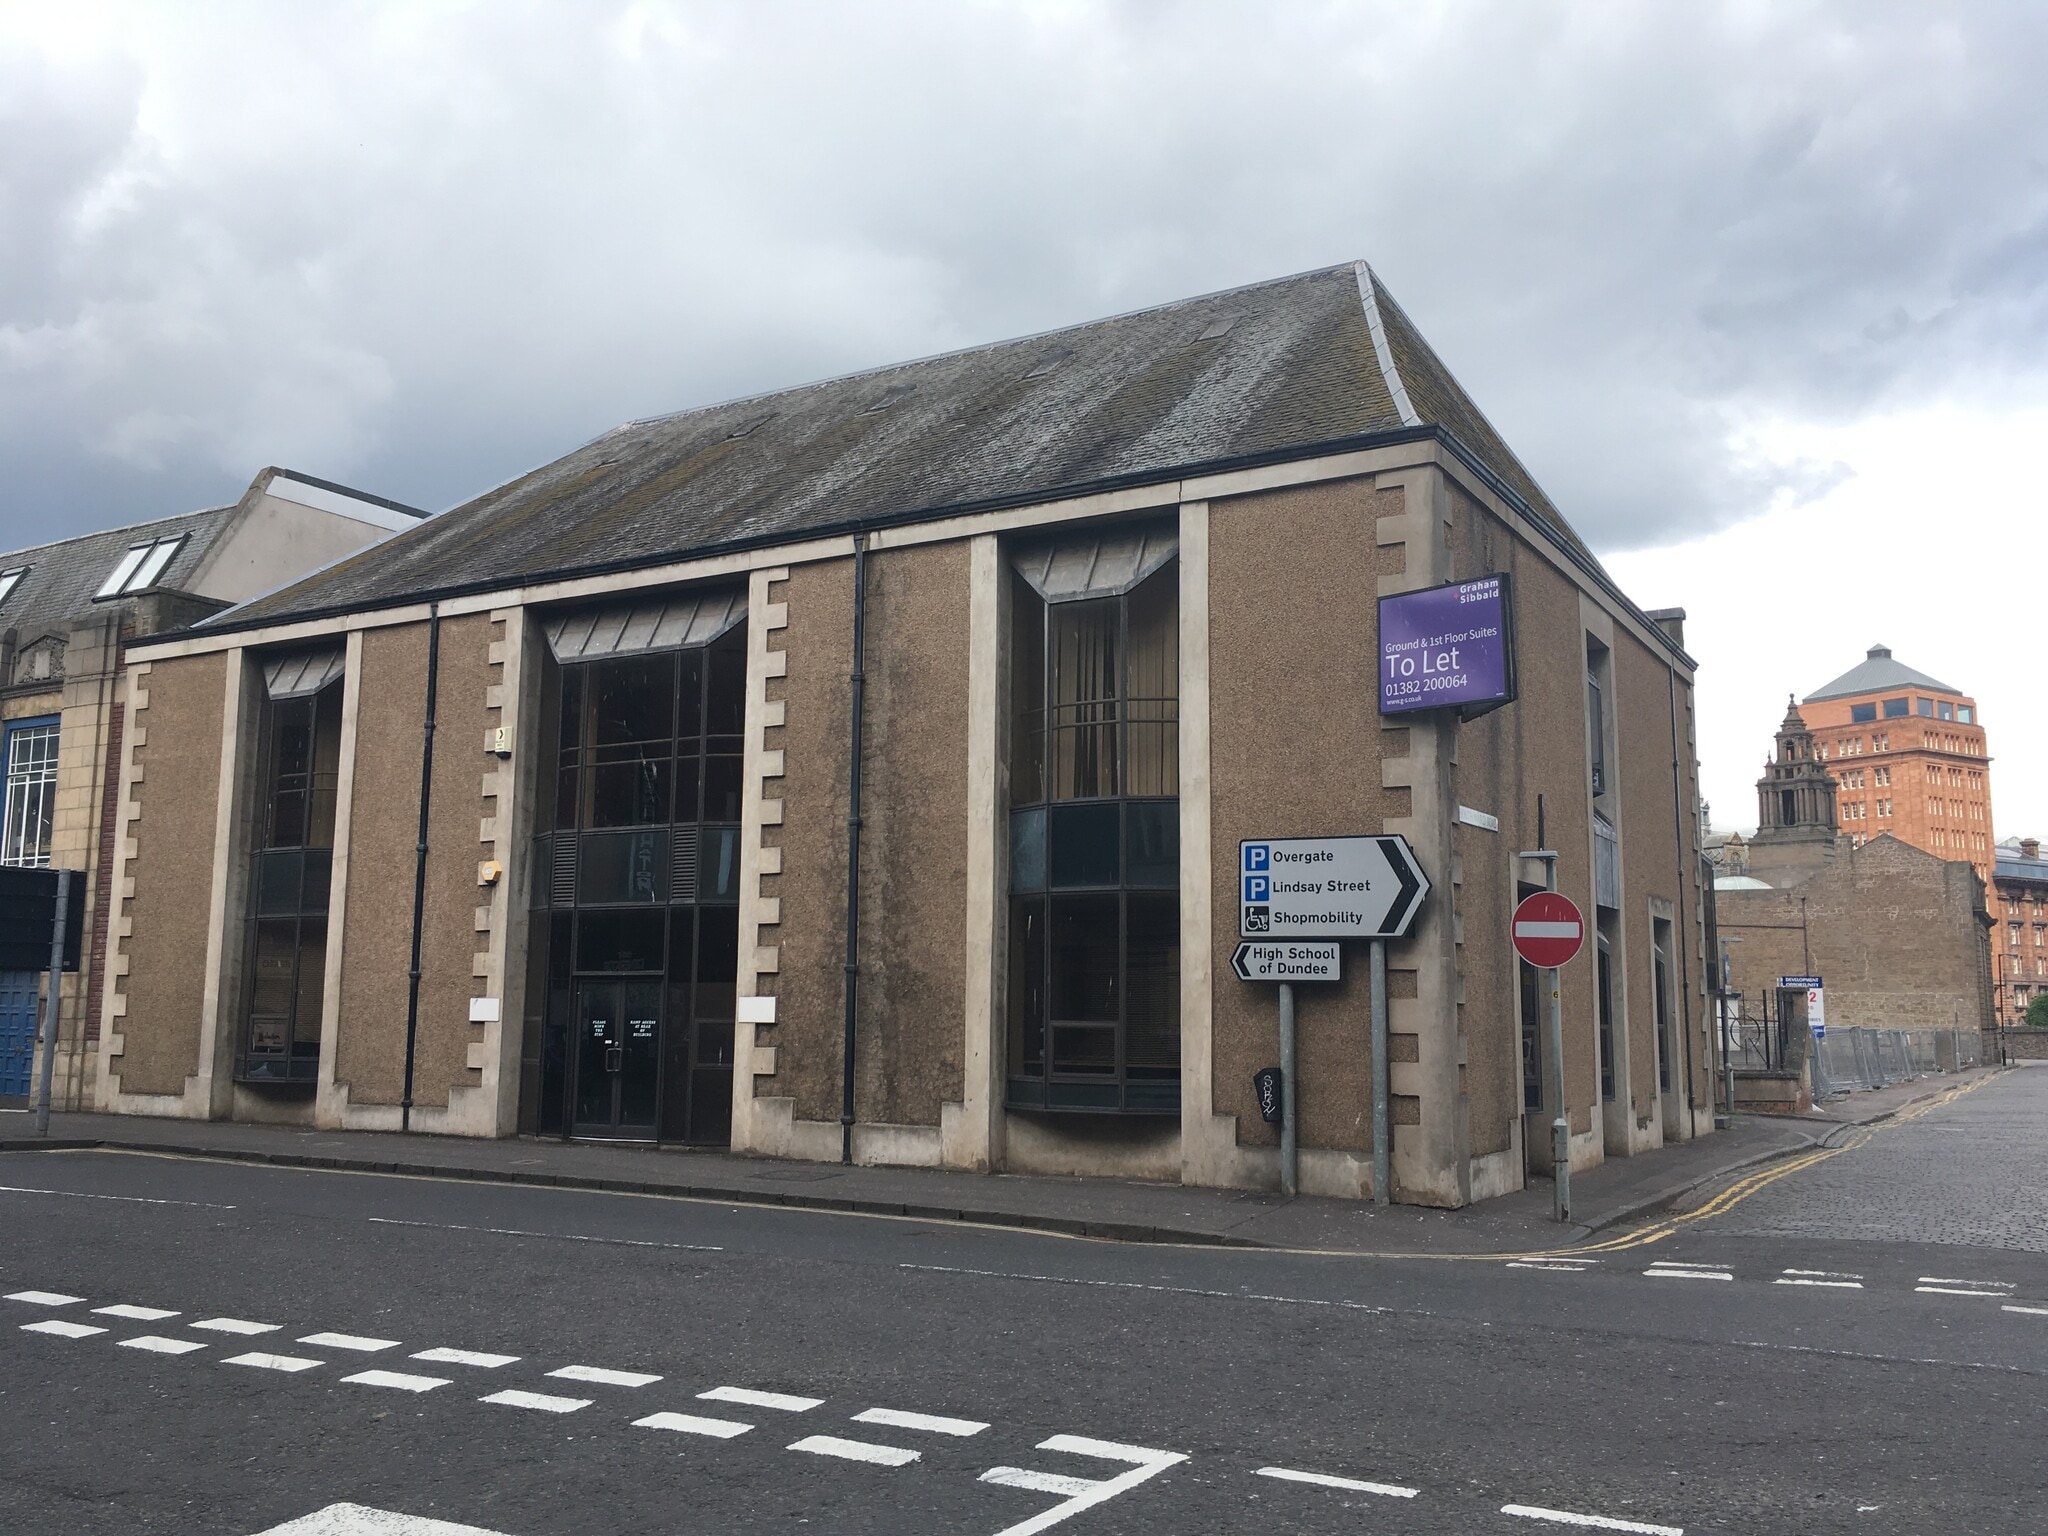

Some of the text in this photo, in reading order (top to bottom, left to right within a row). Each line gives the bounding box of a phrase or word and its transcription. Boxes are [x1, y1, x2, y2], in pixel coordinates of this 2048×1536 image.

[1460, 580, 1499, 594] Graham
[1460, 589, 1499, 604] Sibbald
[1386, 627, 1497, 652] Ground & 1st Floor Suites
[1386, 647, 1460, 678] To Let
[1386, 674, 1467, 696] 01382 200064
[1251, 848, 1334, 869] P Overgate
[1251, 879, 1370, 899] P Lindsay Street
[1274, 912, 1362, 925] Shopmobility
[1253, 948, 1335, 961] High School
[1259, 962, 1328, 974] of Dundee
